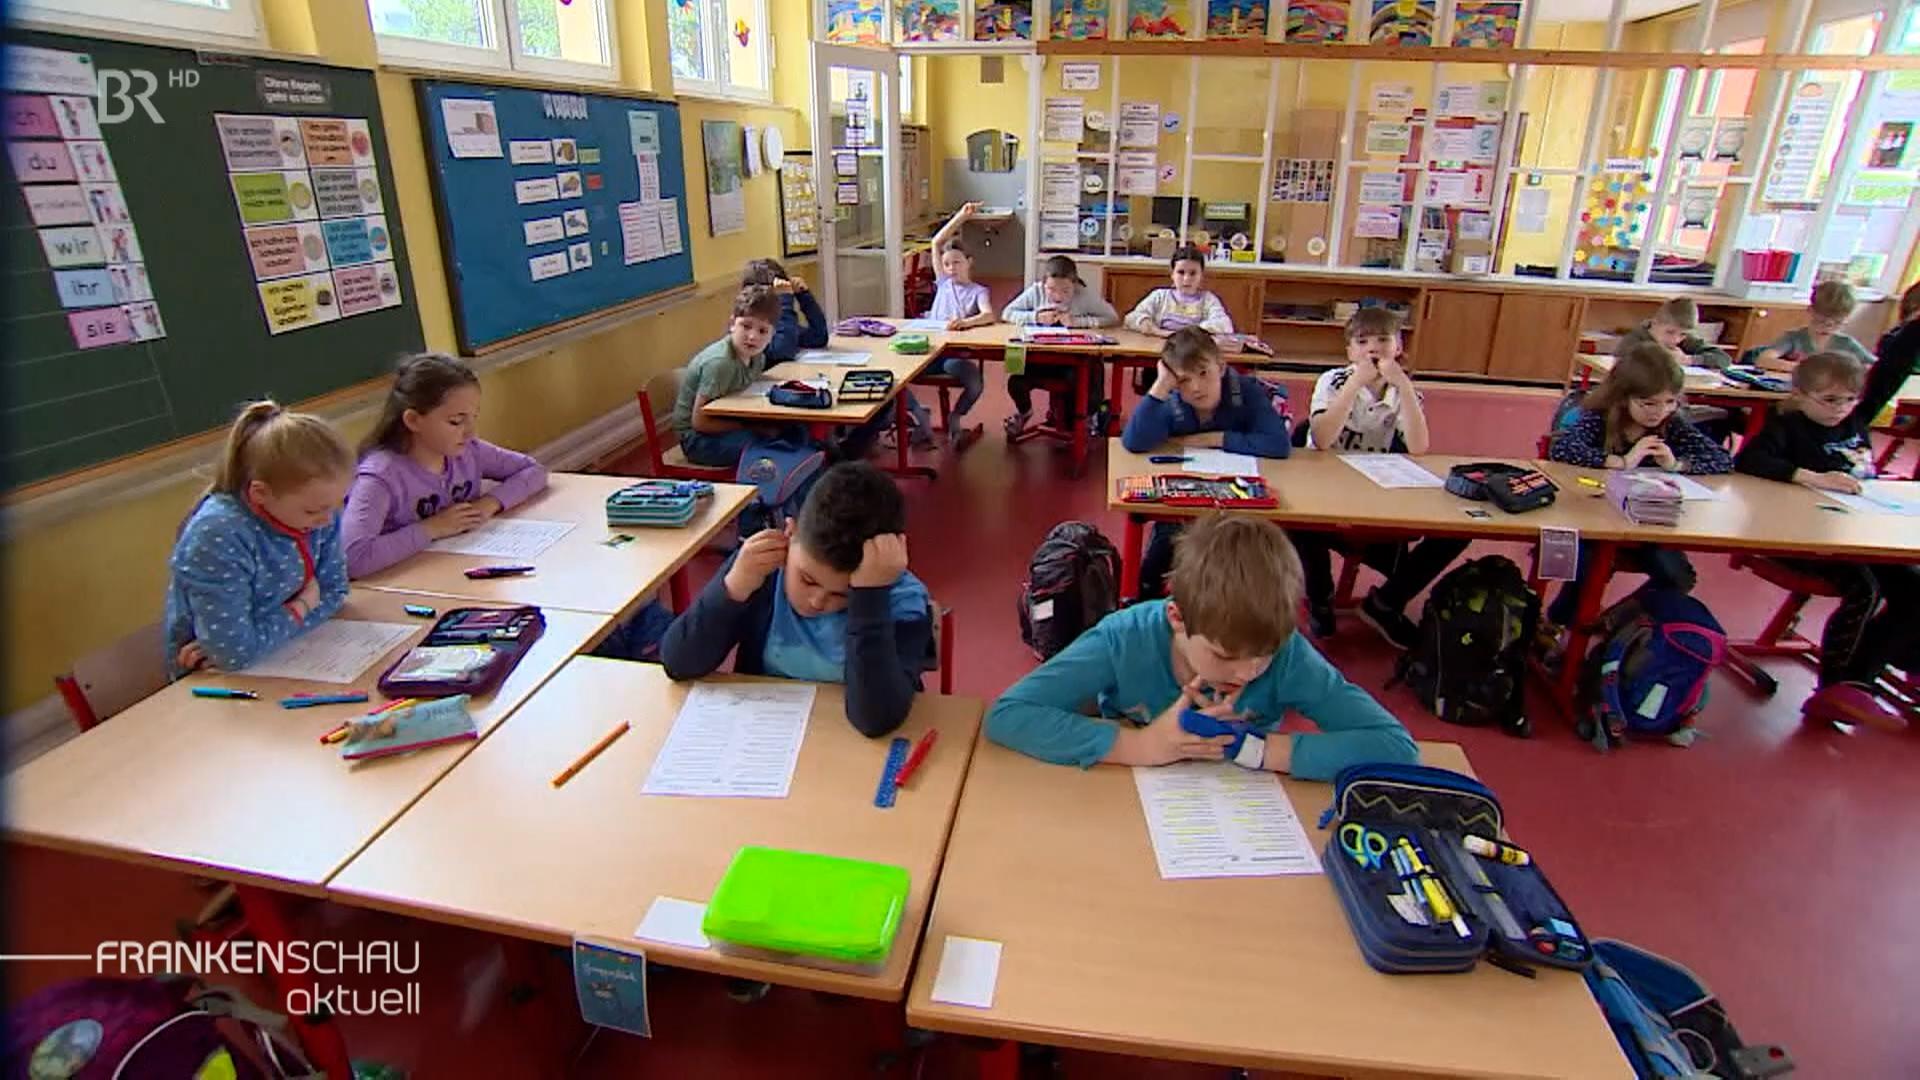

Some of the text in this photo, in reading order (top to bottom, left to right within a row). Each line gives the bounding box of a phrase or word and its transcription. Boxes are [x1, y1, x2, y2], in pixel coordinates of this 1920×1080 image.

[29, 152, 57, 171] du
[54, 237, 90, 256] wir
[70, 279, 100, 297] ihr
[86, 320, 117, 340] sie
